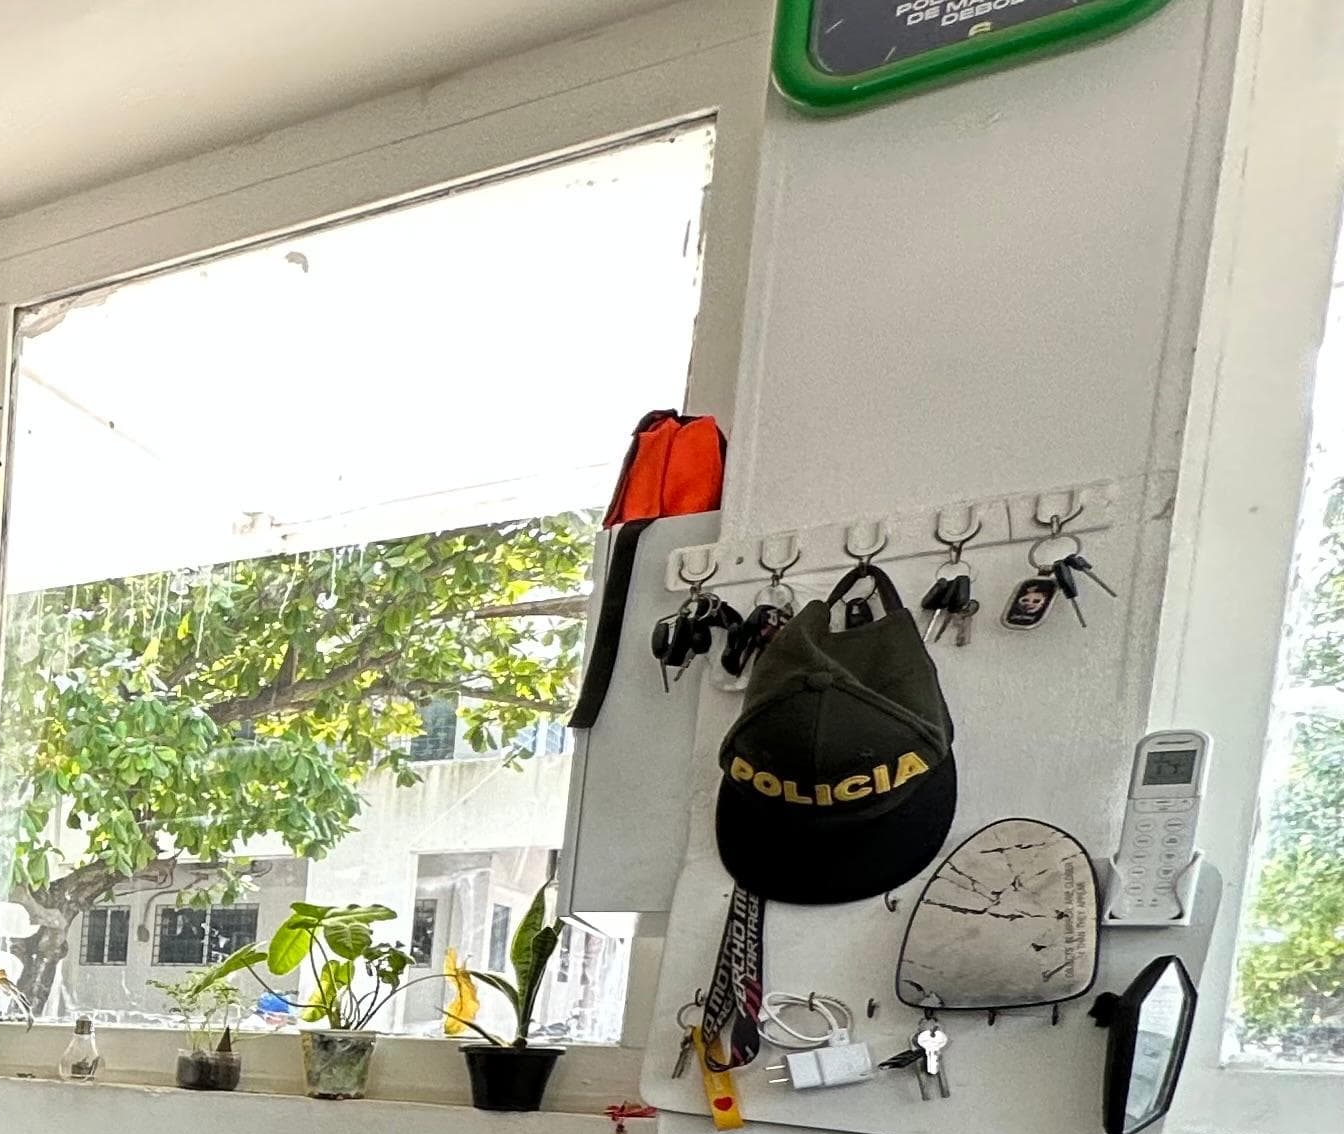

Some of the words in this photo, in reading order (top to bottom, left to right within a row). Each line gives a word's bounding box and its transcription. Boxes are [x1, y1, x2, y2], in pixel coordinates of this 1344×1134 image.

[906, 5, 941, 26] DE
[730, 751, 930, 806] POLICIA
[732, 918, 747, 1018] FERCHO
